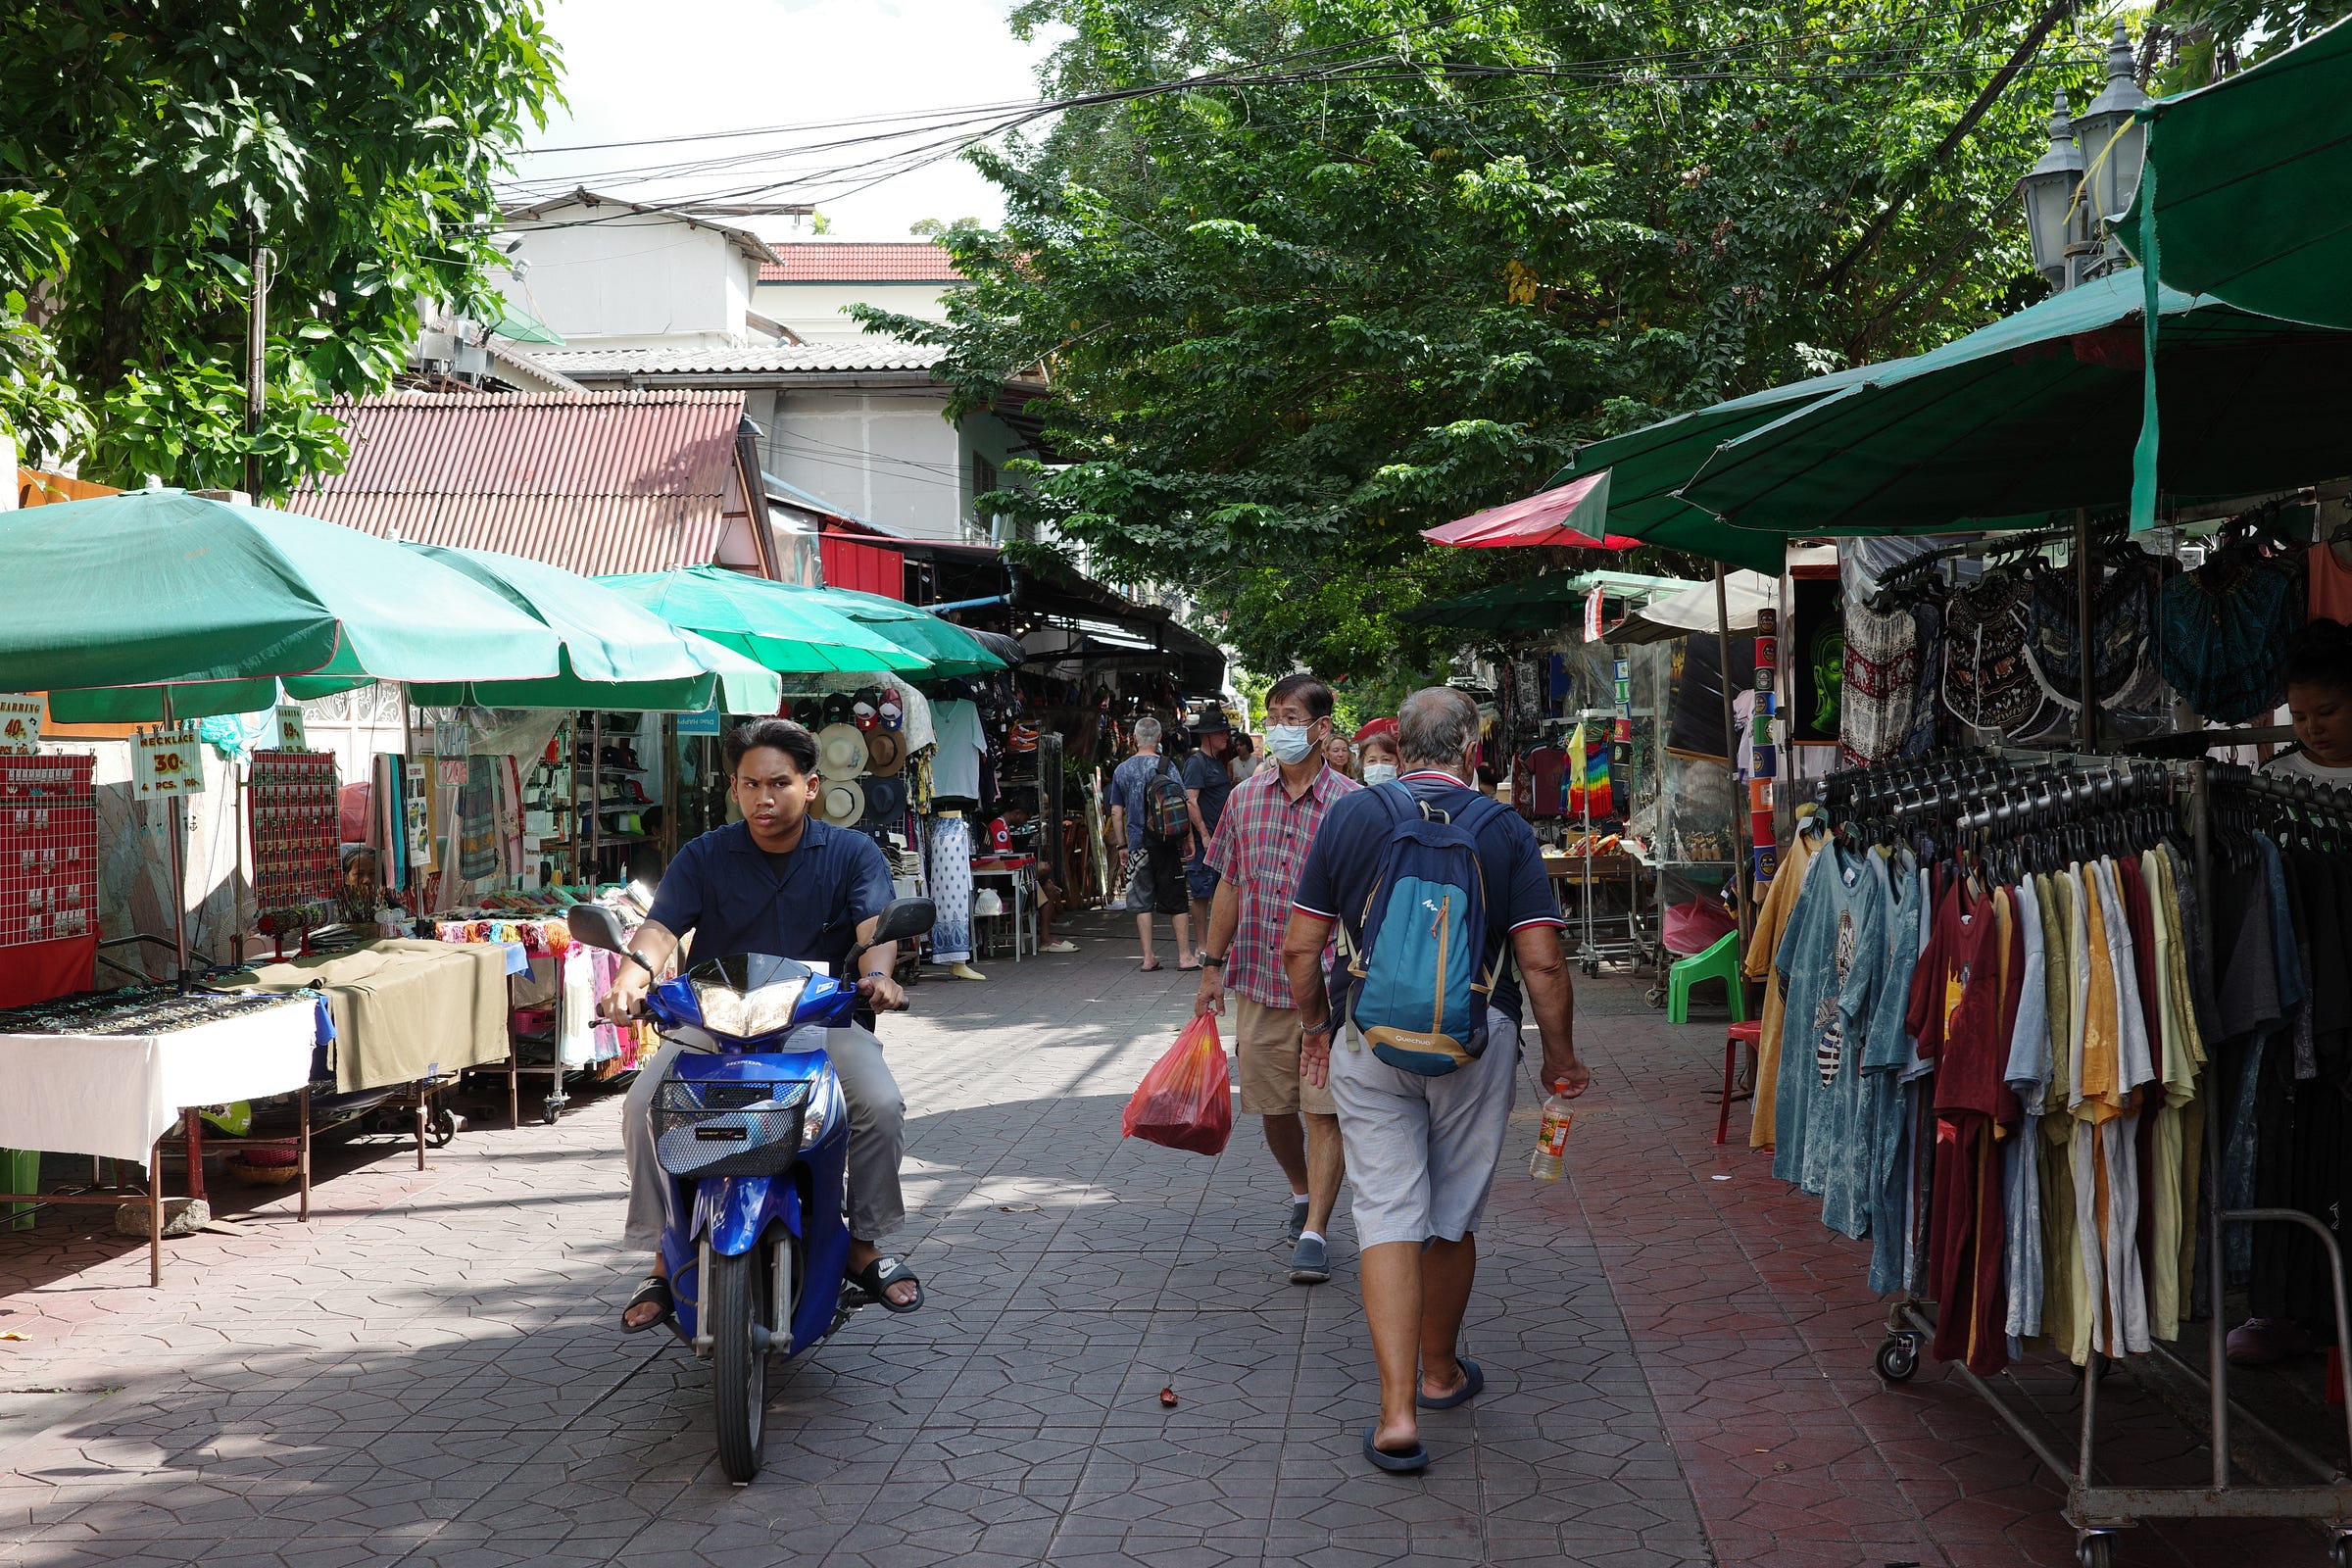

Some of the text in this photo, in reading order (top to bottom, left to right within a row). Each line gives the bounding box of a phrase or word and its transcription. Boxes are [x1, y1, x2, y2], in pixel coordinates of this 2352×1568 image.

[0, 702, 40, 713] EARRING
[140, 734, 195, 747] NECKLACE
[1395, 1035, 1431, 1047] Quechua
[878, 1257, 896, 1271] NIKE
